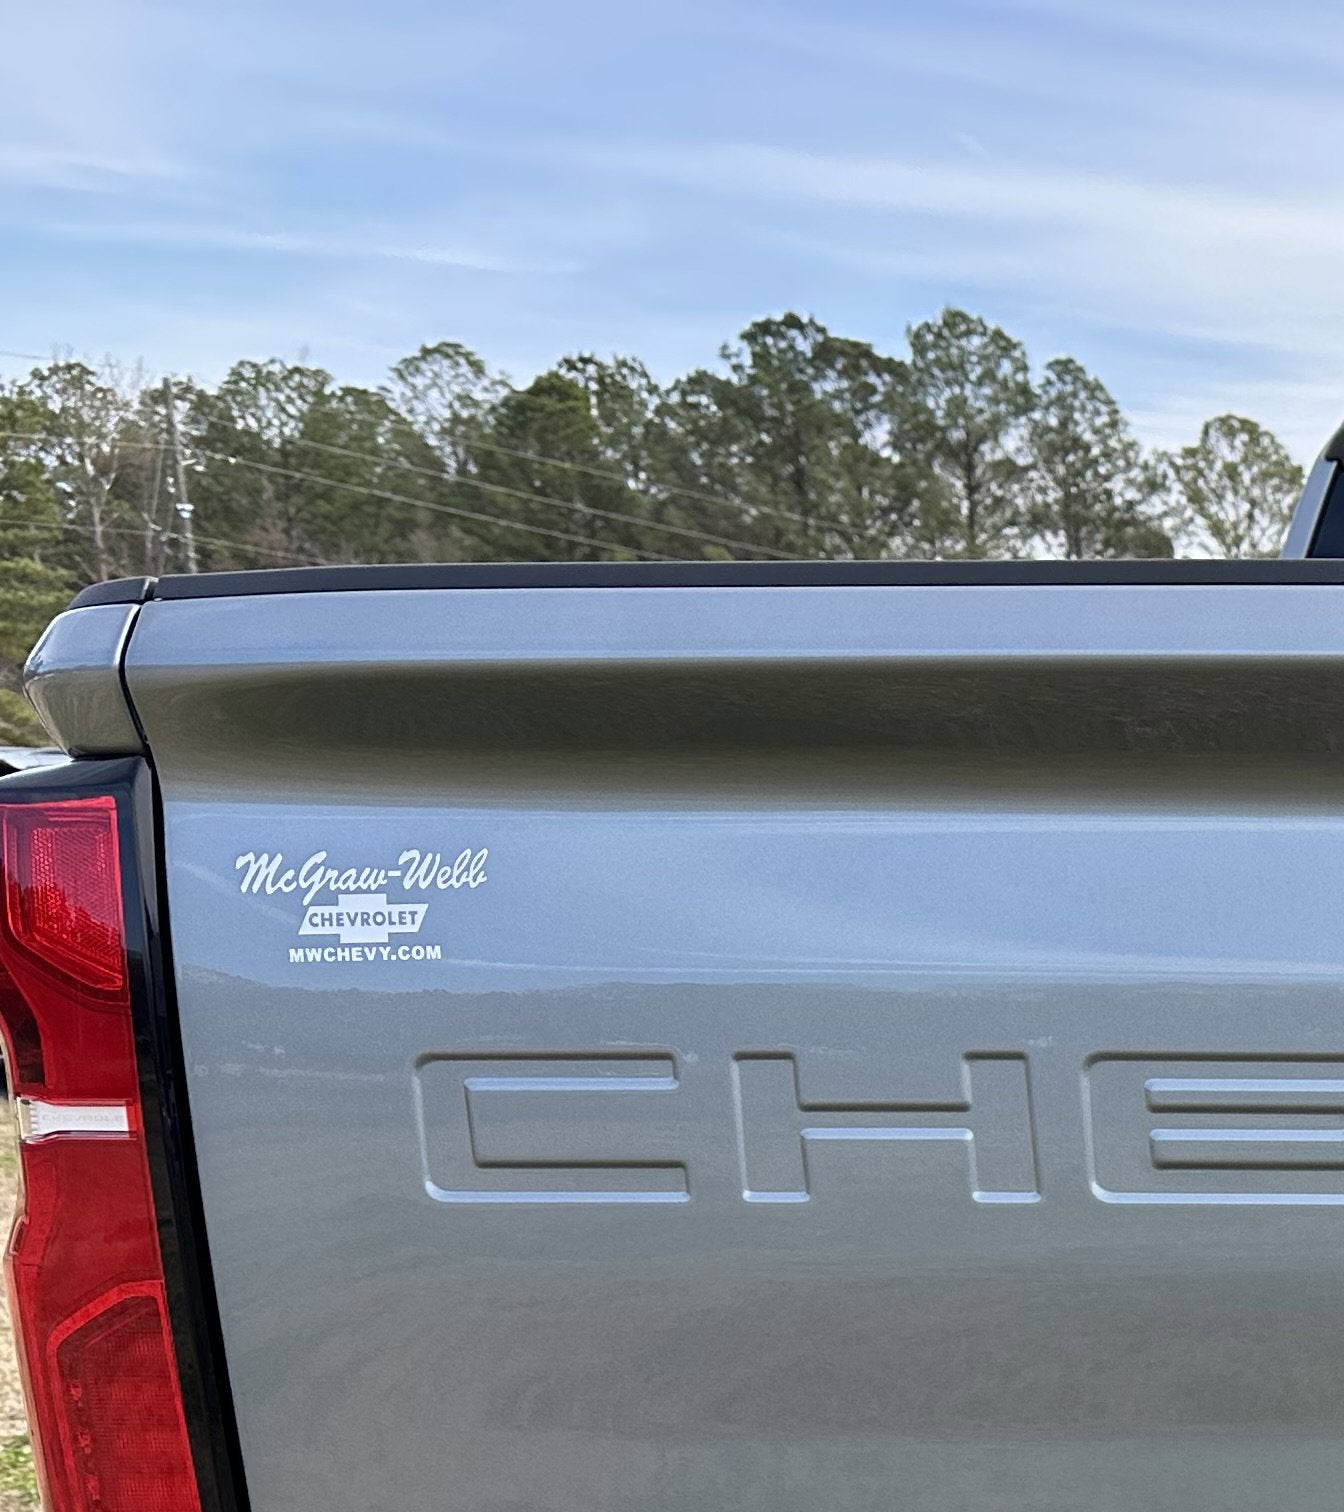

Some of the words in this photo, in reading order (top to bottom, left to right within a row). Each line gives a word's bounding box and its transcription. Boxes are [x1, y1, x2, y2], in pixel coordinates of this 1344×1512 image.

[235, 848, 488, 906] McGraw-Webb
[309, 910, 418, 928] CHEVROLET
[289, 946, 442, 963] MWCHEVY.COM
